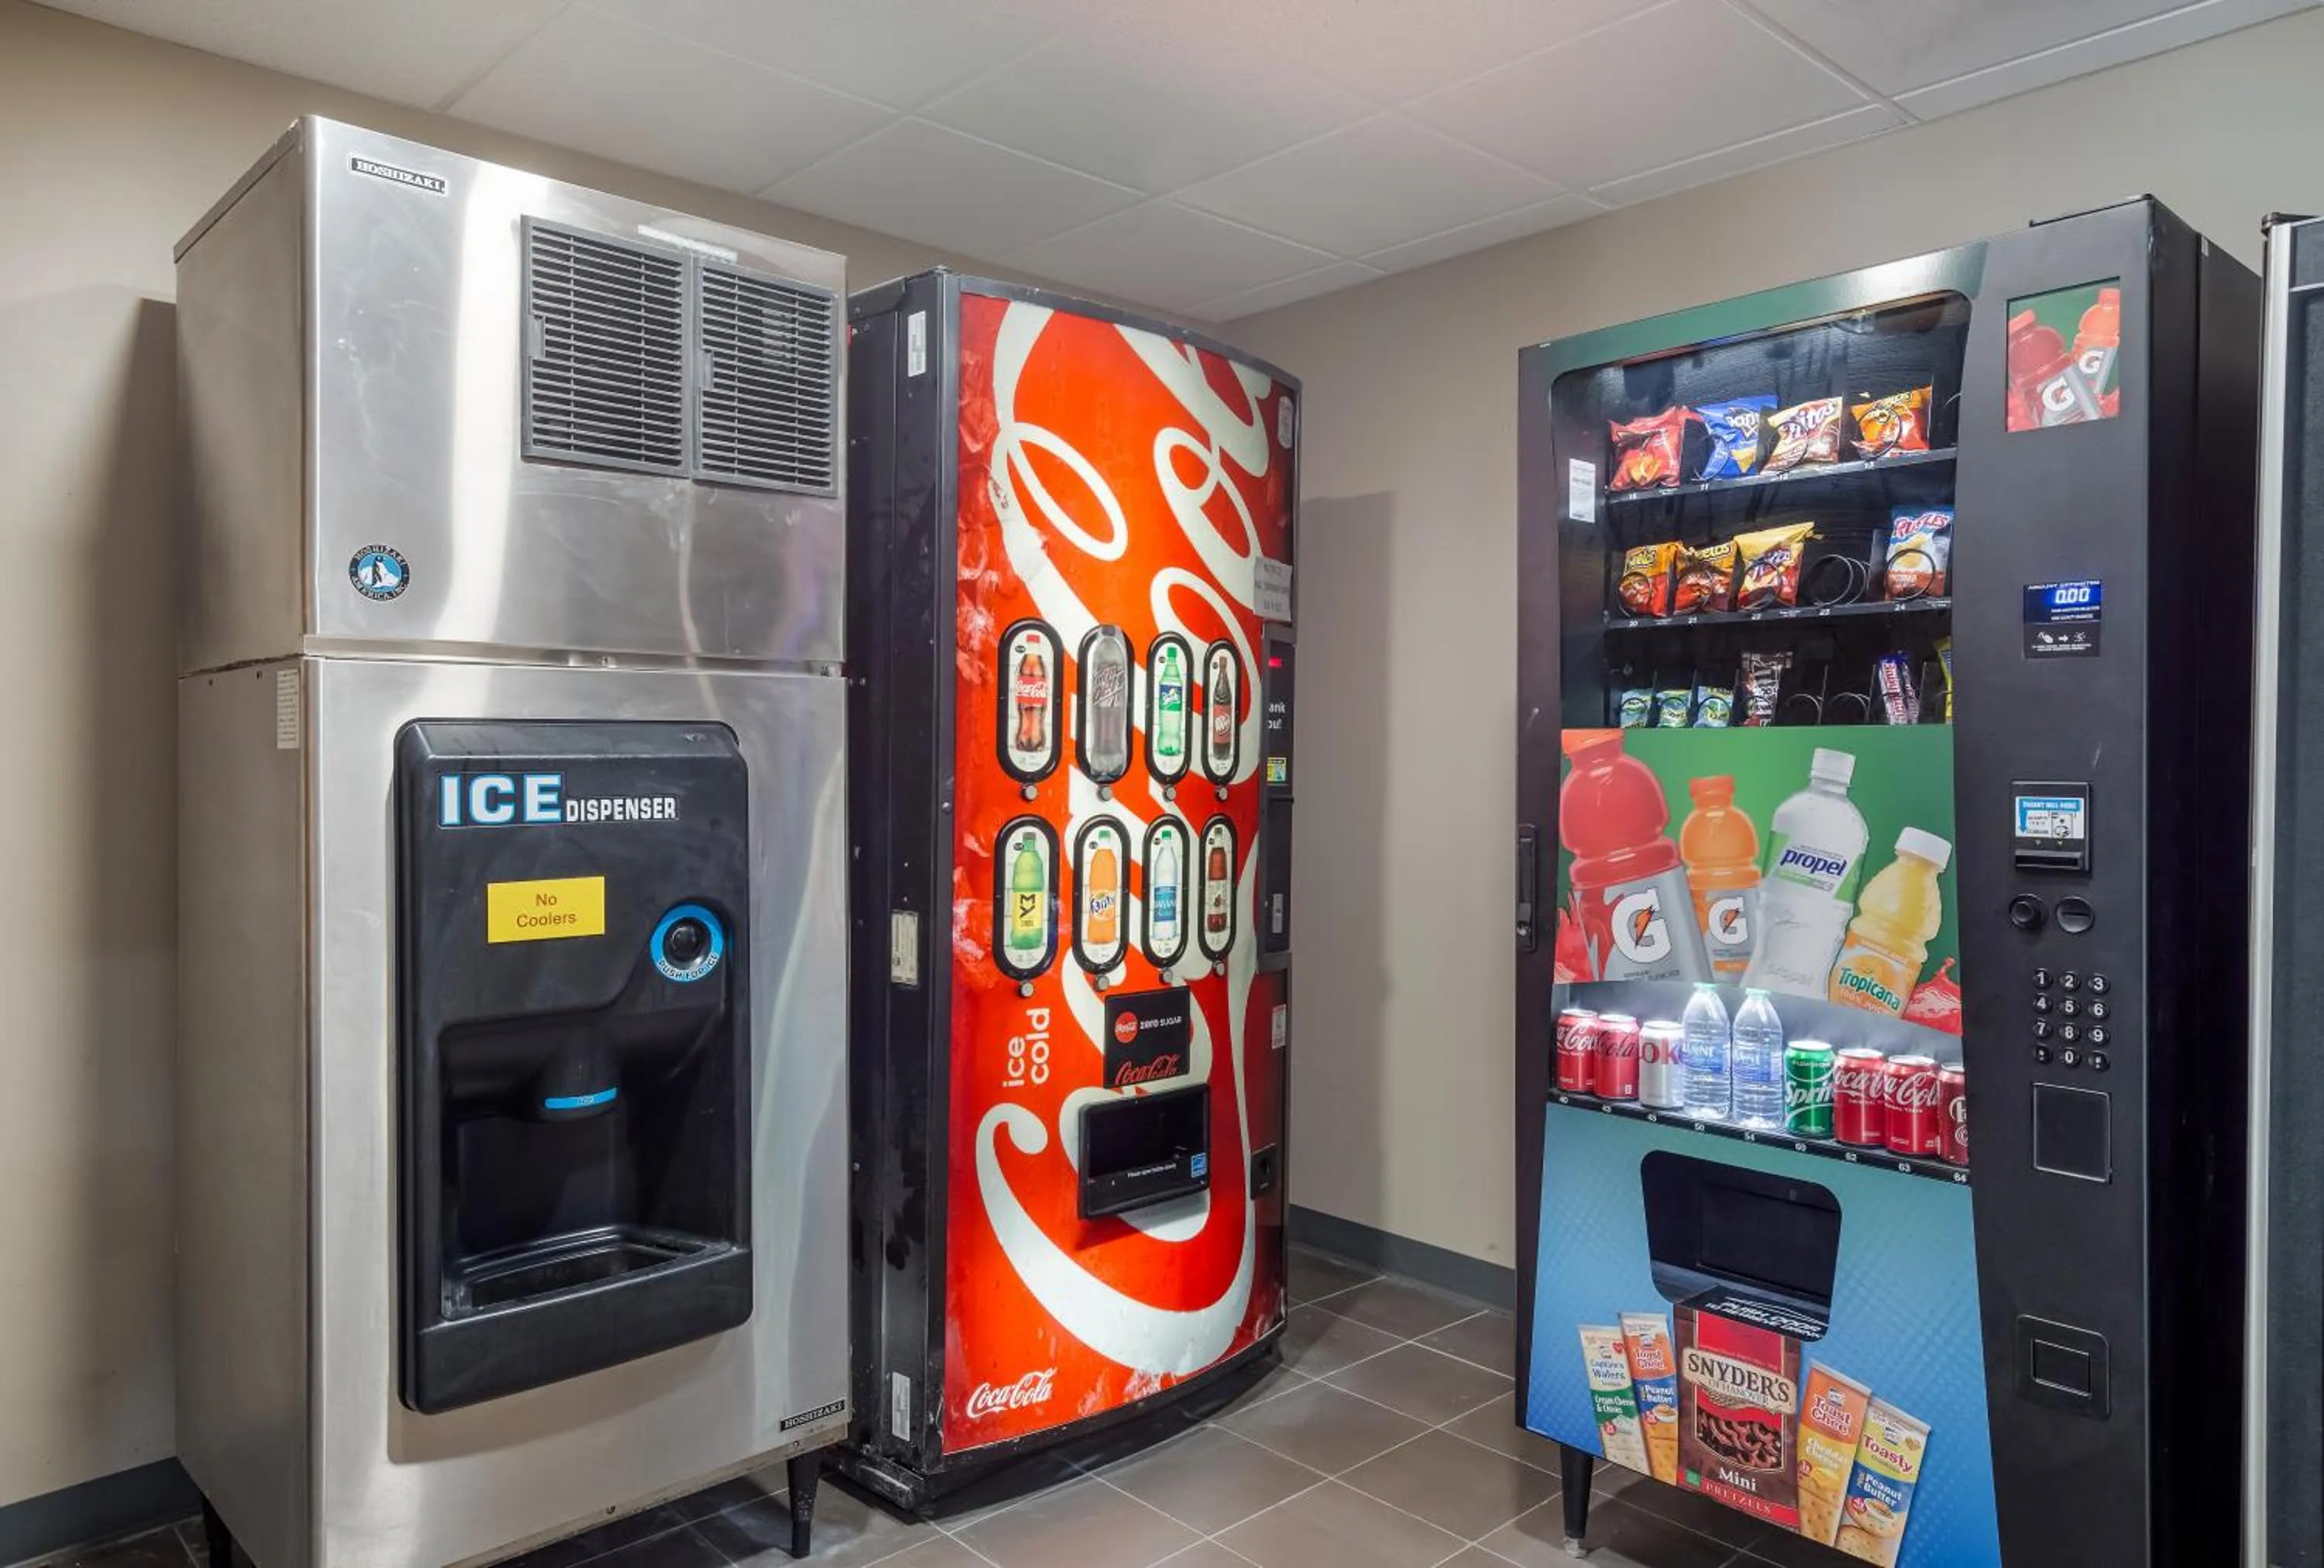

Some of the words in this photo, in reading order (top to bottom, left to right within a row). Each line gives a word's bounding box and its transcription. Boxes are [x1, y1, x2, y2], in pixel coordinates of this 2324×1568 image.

[356, 160, 442, 191] HOSHIZAKI
[2041, 376, 2075, 411] G
[440, 773, 562, 826] ICE
[566, 796, 678, 823] DISPENSER
[1779, 849, 1848, 877] propel
[535, 892, 558, 907] No
[516, 911, 578, 929] Coolers
[1611, 888, 1672, 965] G
[1708, 897, 1748, 944] G
[1838, 967, 1901, 1011] Tropicana
[2037, 971, 2044, 985] 1
[2064, 975, 2074, 988] 2
[2094, 977, 2103, 990] 3
[2037, 997, 2046, 1009] 4
[2064, 1000, 2074, 1013] 5
[2094, 1003, 2103, 1016] 6
[2037, 1023, 2045, 1035] 7
[2064, 1026, 2074, 1039] 8
[2093, 1029, 2103, 1042] 9
[1026, 1007, 1050, 1084] cold
[2064, 1050, 2074, 1064] 0
[1003, 1036, 1025, 1087] ice
[1784, 1080, 1834, 1108] Sprit
[1687, 1353, 1792, 1403] SNYDER'S
[967, 1367, 1058, 1419] Coca-Cola
[1810, 1406, 1850, 1436] Chee
[1813, 1392, 1853, 1425] Toast
[1862, 1434, 1915, 1474] Toasty
[1718, 1467, 1757, 1492] Mini
[1866, 1473, 1903, 1501] Peanut
[1706, 1482, 1772, 1514] PRETZELS
[1863, 1483, 1898, 1507] Butter
